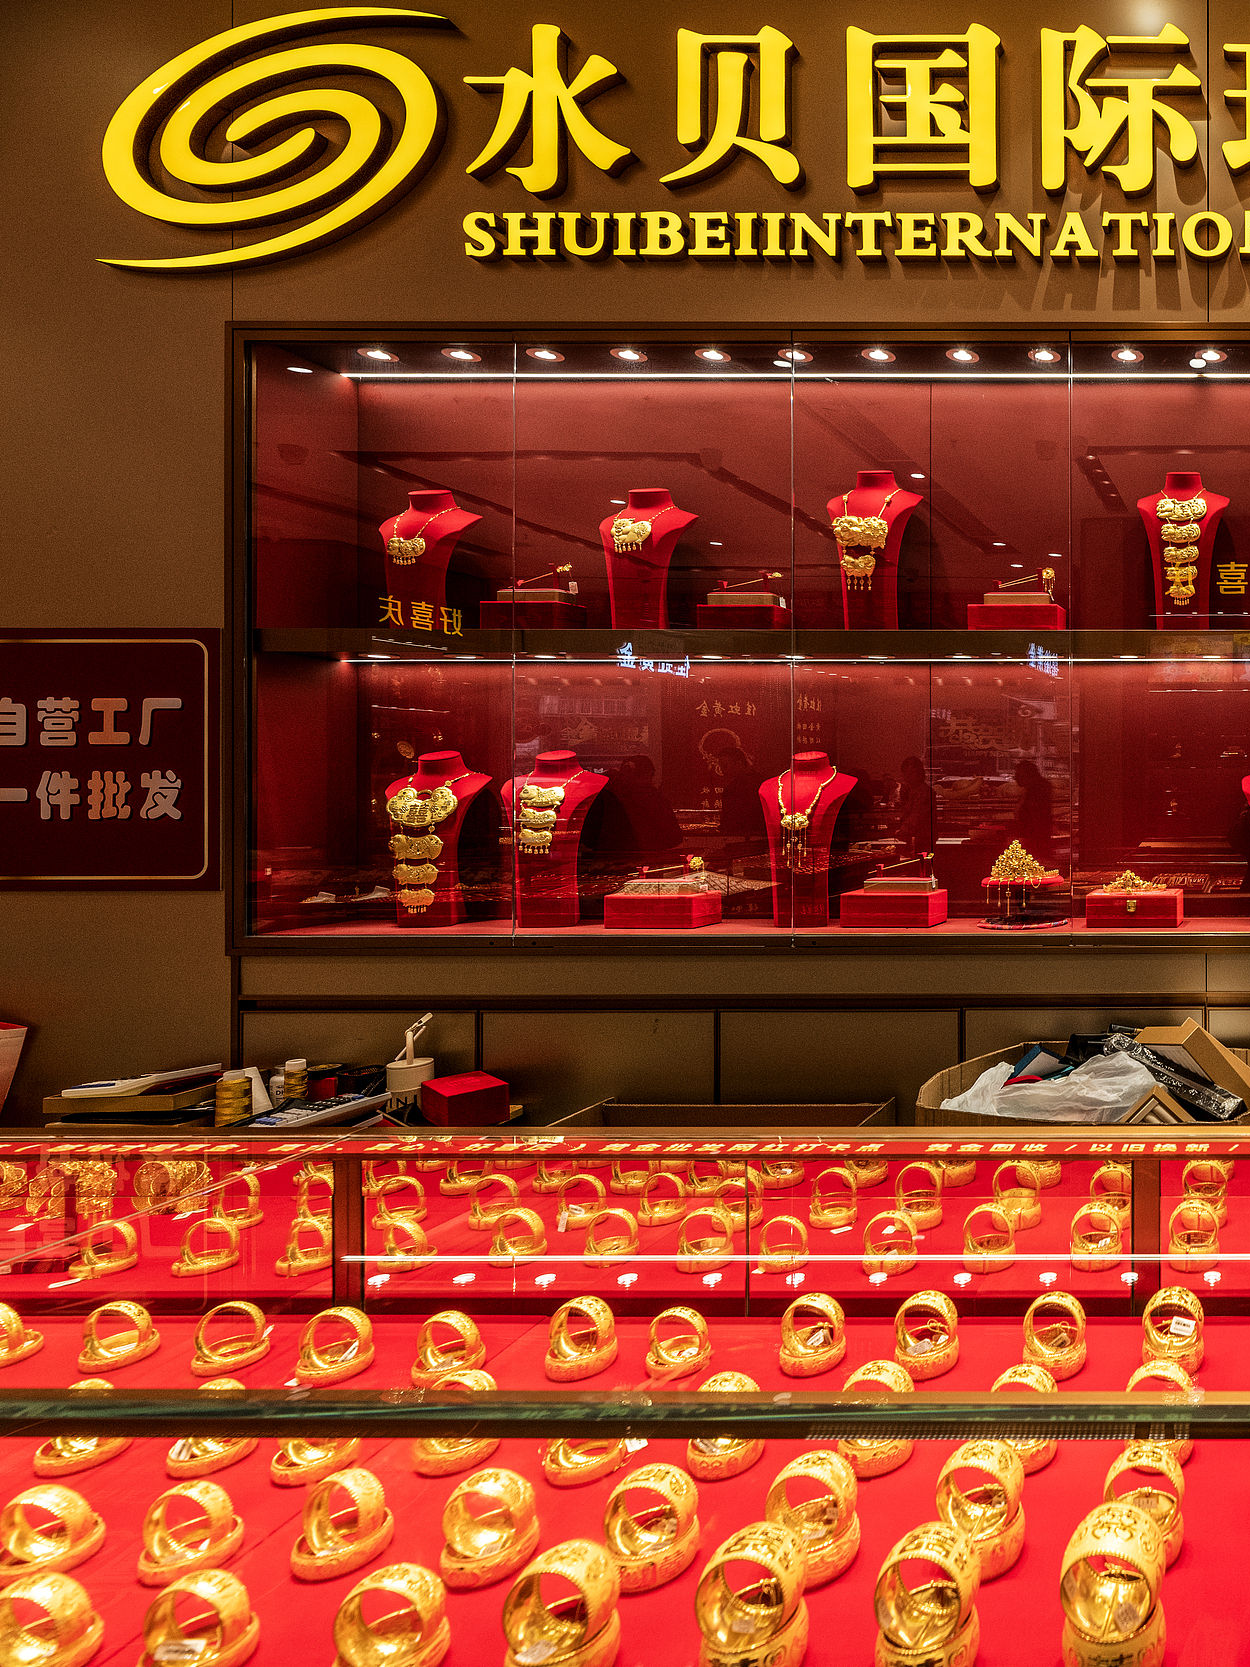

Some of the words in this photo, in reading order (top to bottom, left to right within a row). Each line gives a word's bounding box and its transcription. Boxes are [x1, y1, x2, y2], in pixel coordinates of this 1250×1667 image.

[0, 696, 182, 746] 自营工厂
[0, 770, 182, 820] 一件批发
